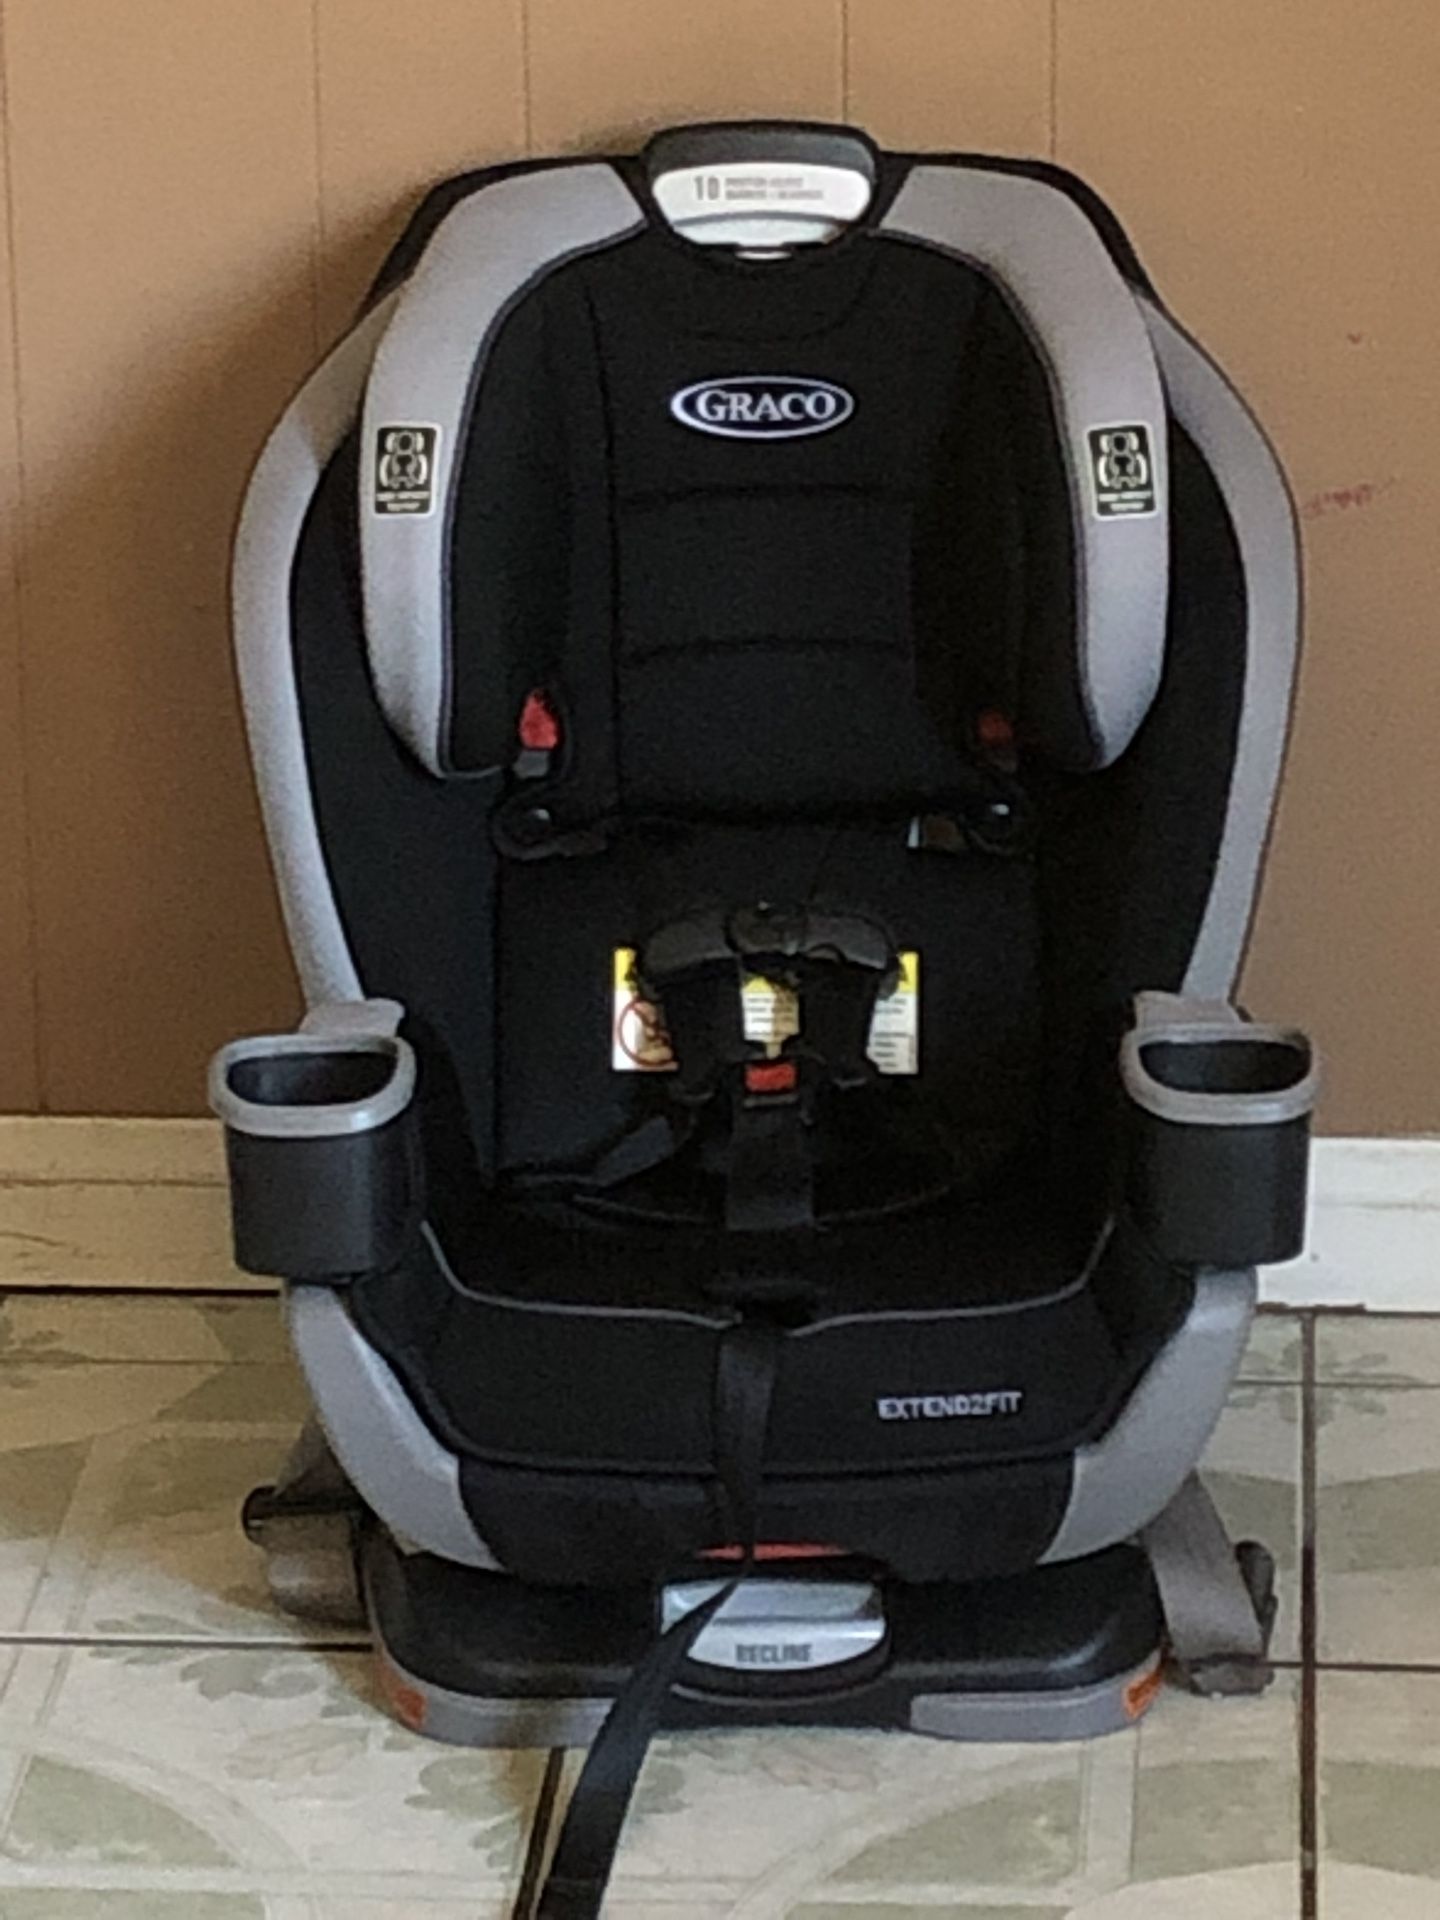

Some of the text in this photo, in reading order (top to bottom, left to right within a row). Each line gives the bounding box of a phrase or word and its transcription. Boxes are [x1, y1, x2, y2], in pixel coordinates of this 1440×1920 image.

[694, 174, 720, 200] 10
[696, 388, 836, 421] GRACO
[878, 1391, 1022, 1419] EXTEND2FIT
[735, 1644, 812, 1663] RECLINE
